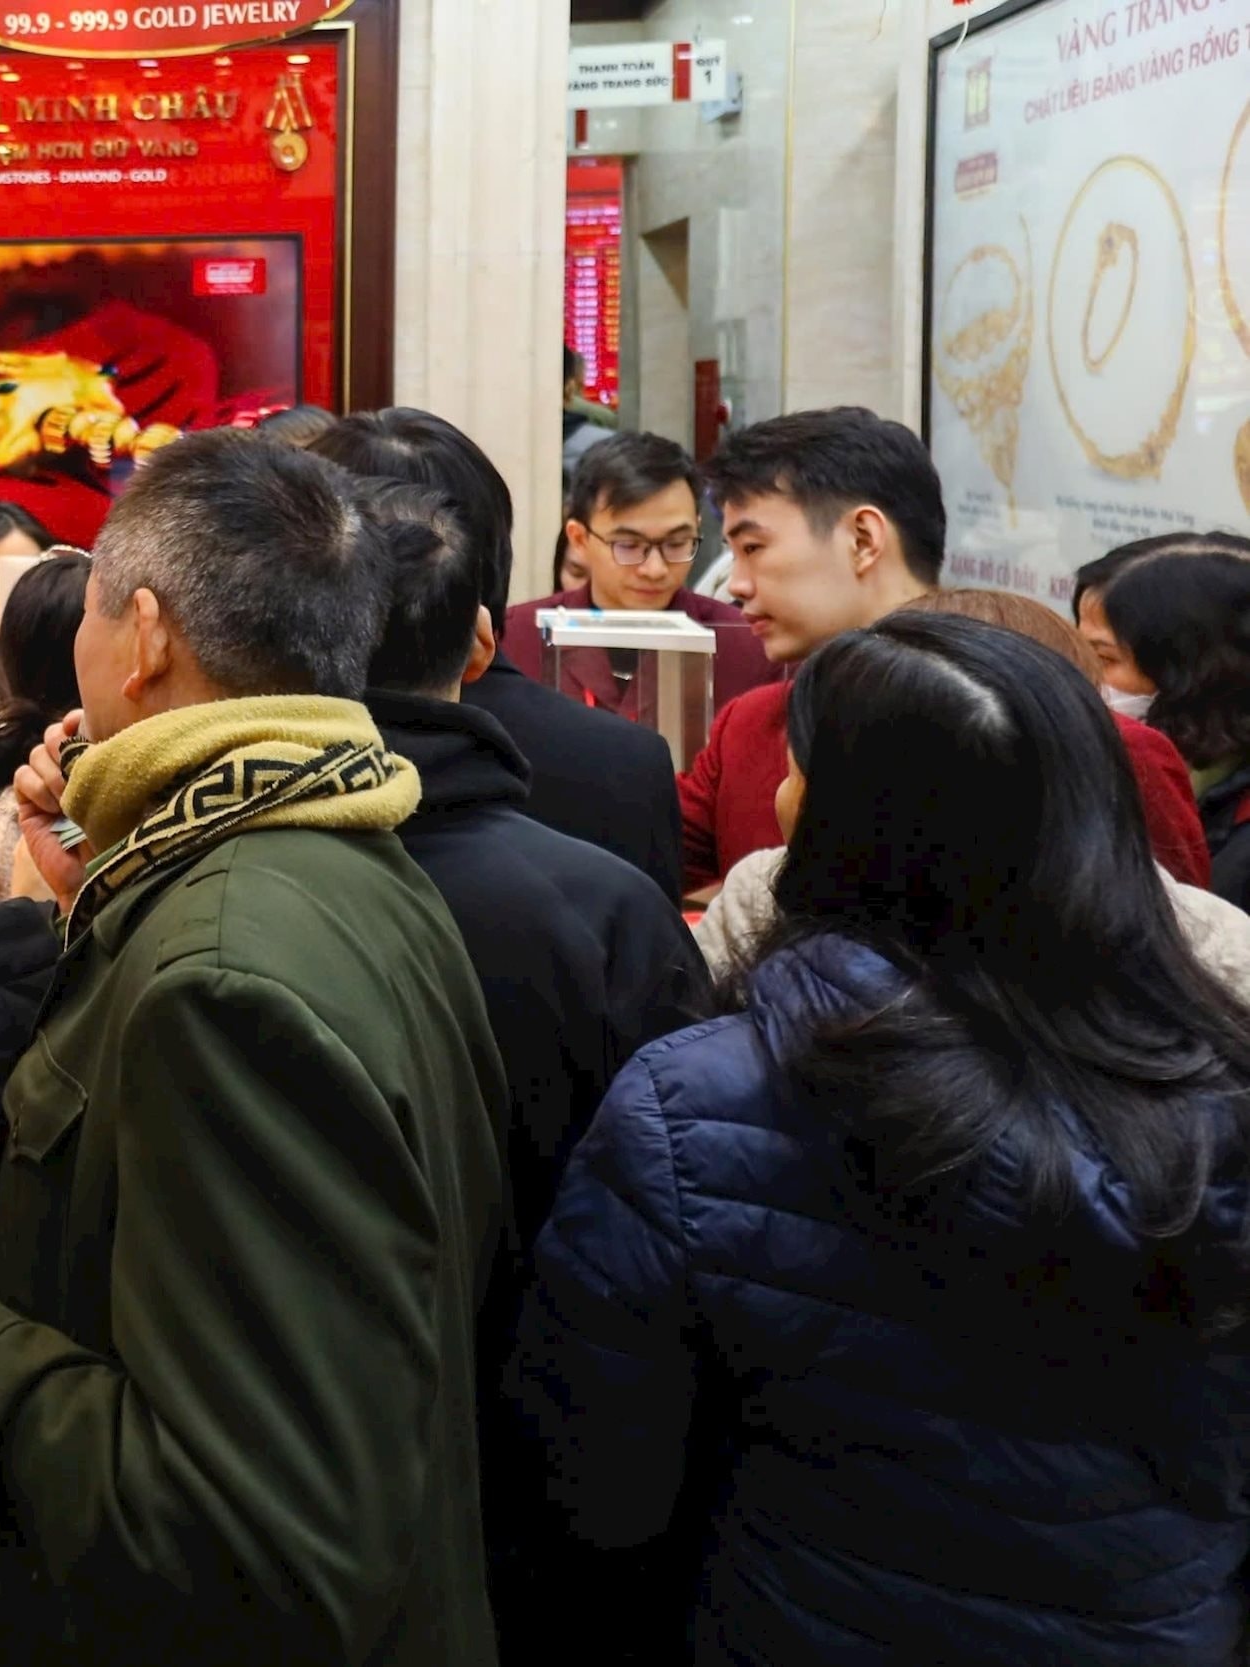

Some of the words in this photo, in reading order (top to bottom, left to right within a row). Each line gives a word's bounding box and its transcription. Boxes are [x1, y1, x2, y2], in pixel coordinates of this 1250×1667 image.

[5, 13, 50, 35] 99.9
[69, 11, 128, 32] 999.9
[133, 5, 196, 30] GOLD
[202, 1, 302, 30] JEWELRY
[1056, 12, 1117, 63] VÀNG
[578, 63, 619, 75] THANH
[704, 70, 712, 84] 1
[1138, 49, 1184, 85] VÀNG
[15, 96, 119, 123] MINH
[133, 87, 239, 121] CHÂU
[59, 169, 122, 184] DIAMOND
[129, 168, 167, 183] GOLD
